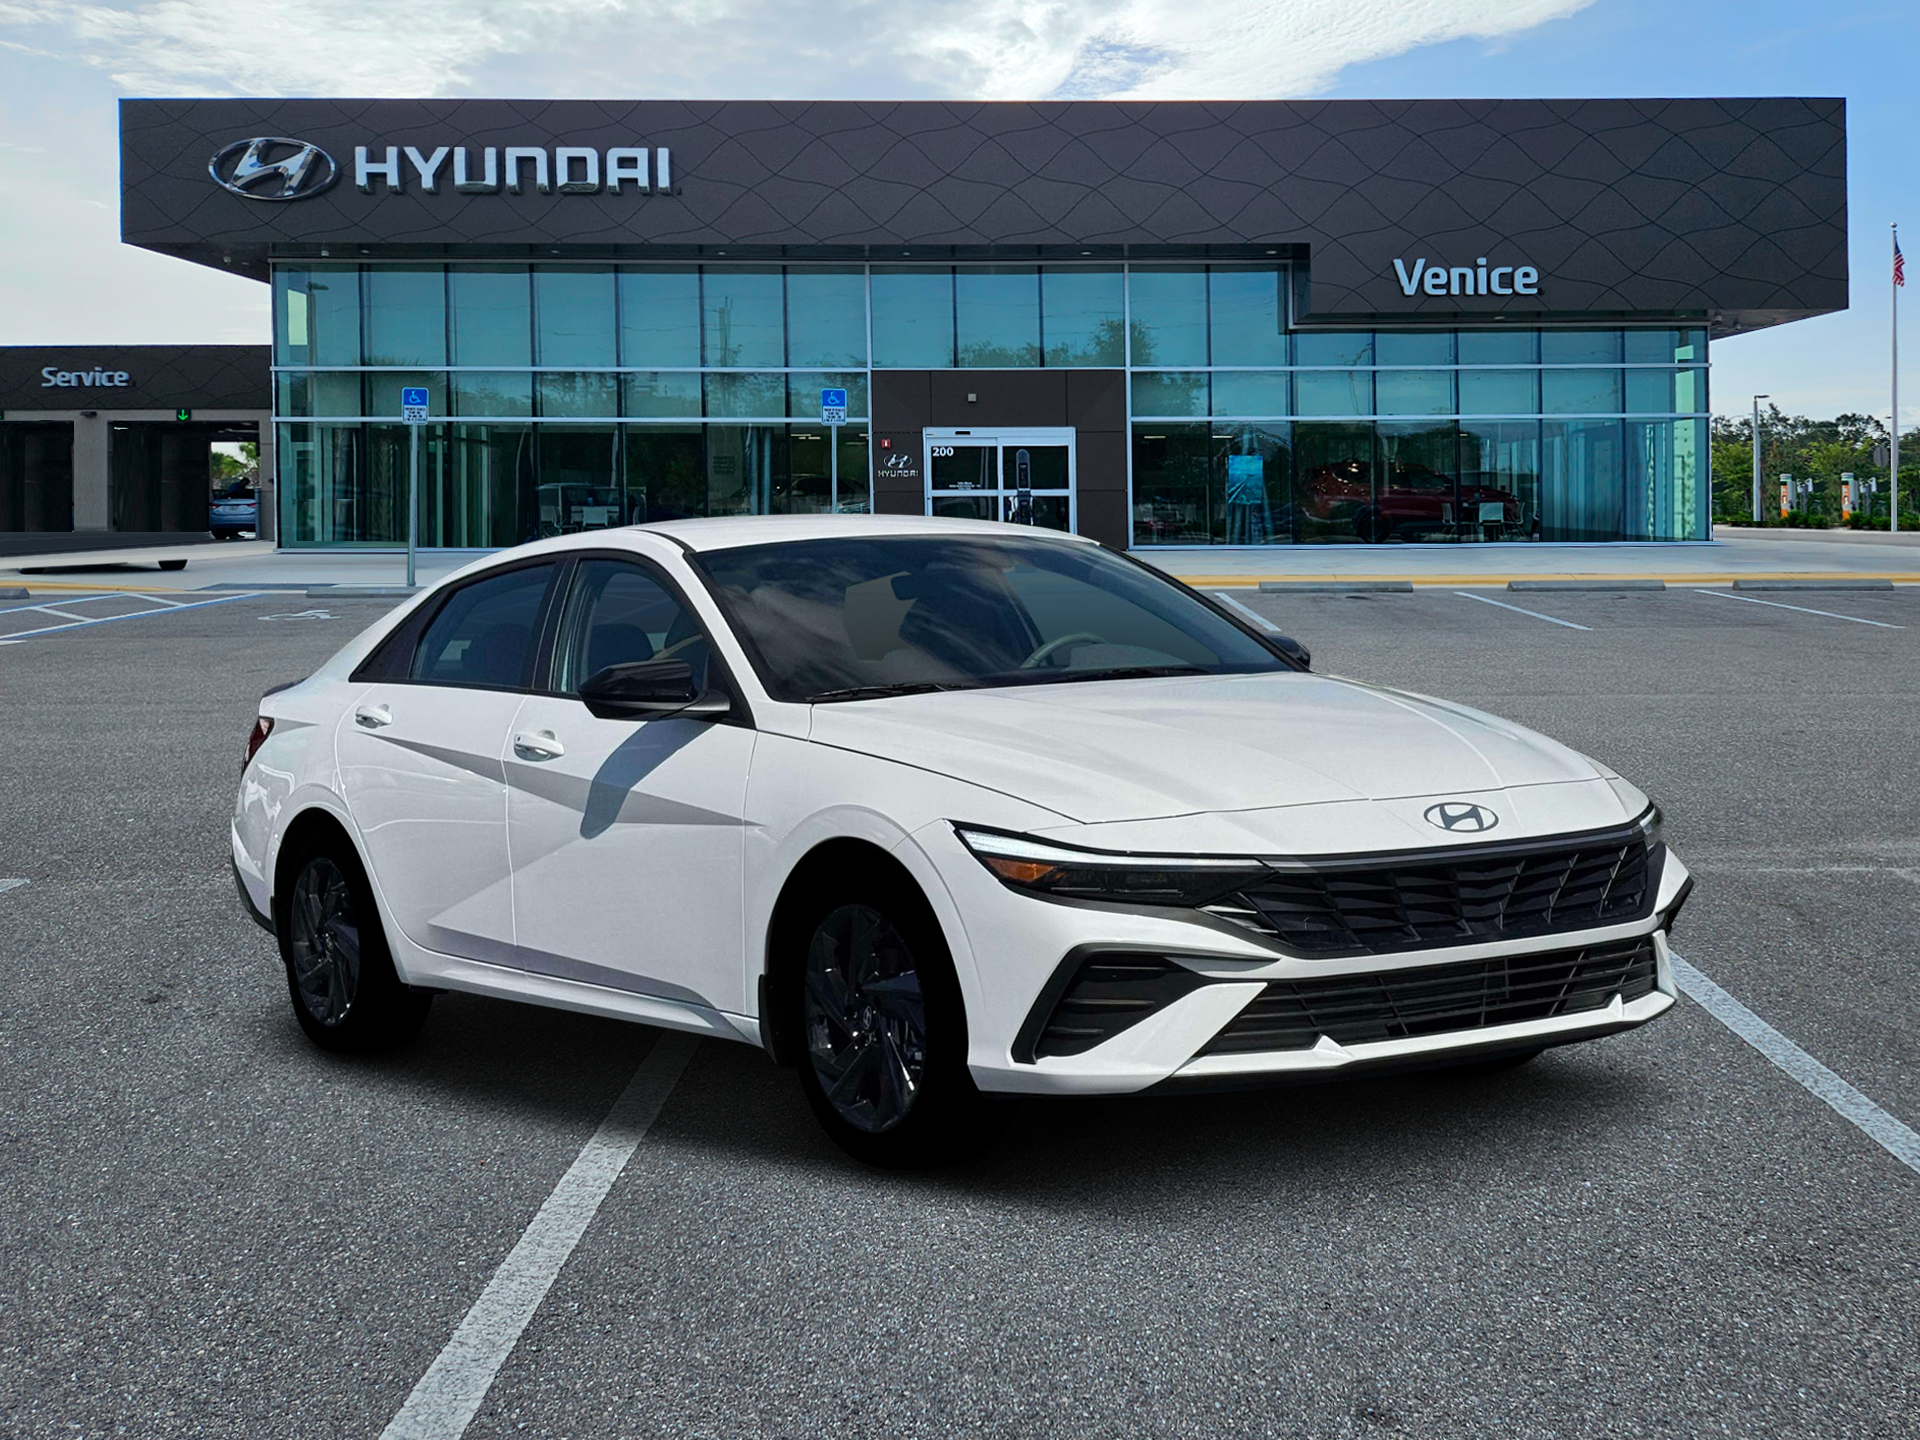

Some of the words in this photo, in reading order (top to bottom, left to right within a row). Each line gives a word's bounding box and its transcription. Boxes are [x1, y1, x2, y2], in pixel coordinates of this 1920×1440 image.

[354, 146, 670, 193] HYUNDAI
[1393, 257, 1539, 296] Venice
[42, 367, 130, 387] Service
[932, 446, 954, 457] 200
[877, 470, 919, 478] HYUNDAI
